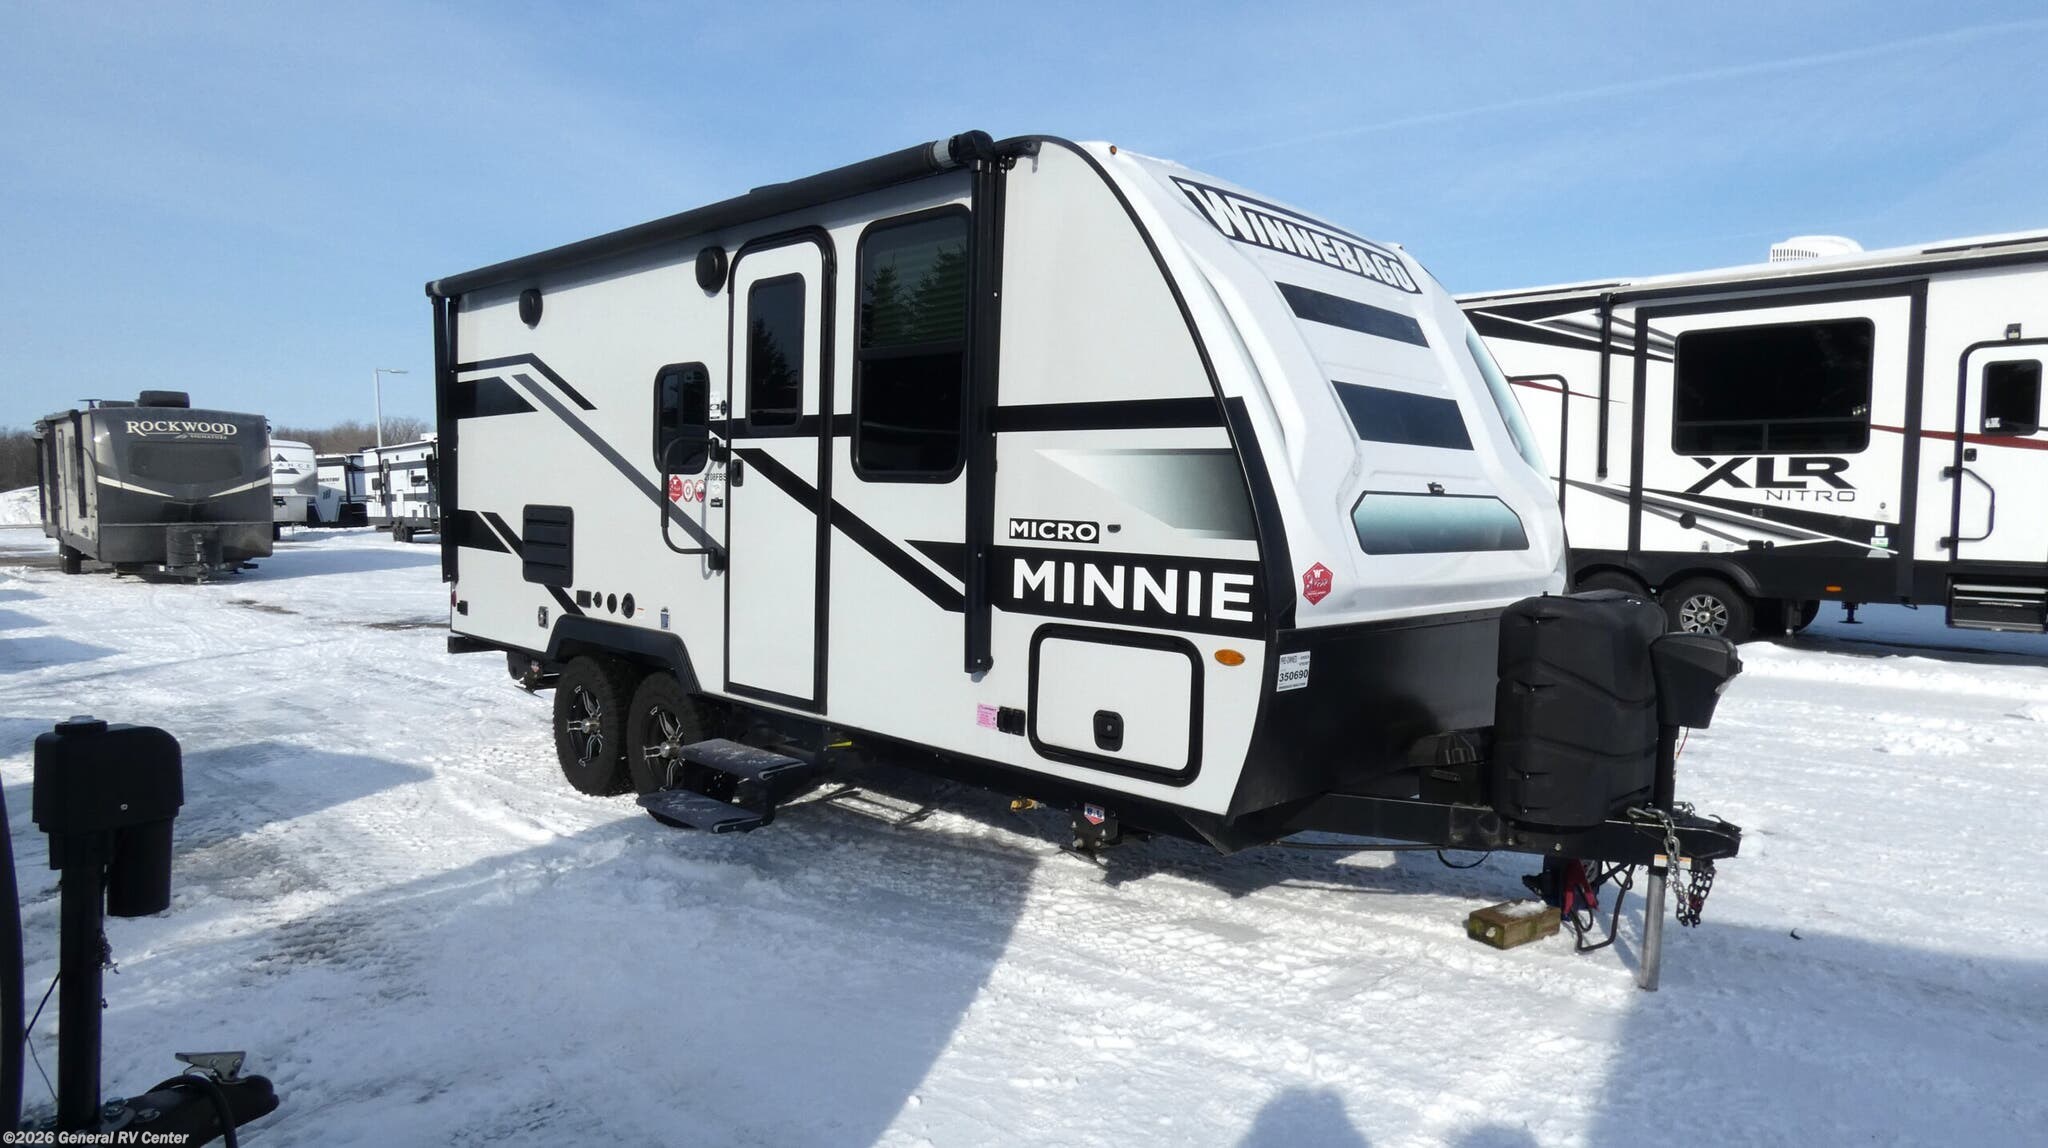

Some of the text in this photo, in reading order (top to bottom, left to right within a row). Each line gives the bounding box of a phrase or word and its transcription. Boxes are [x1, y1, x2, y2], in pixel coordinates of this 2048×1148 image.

[1177, 181, 1417, 293] WINNEBAGO
[126, 420, 238, 436] ROCKWOOD
[1684, 456, 1858, 495] XLR
[1765, 489, 1856, 502] NITRO
[1010, 520, 1097, 541] MICRO
[1013, 558, 1254, 622] MINNIE
[1279, 669, 1309, 682] 350690
